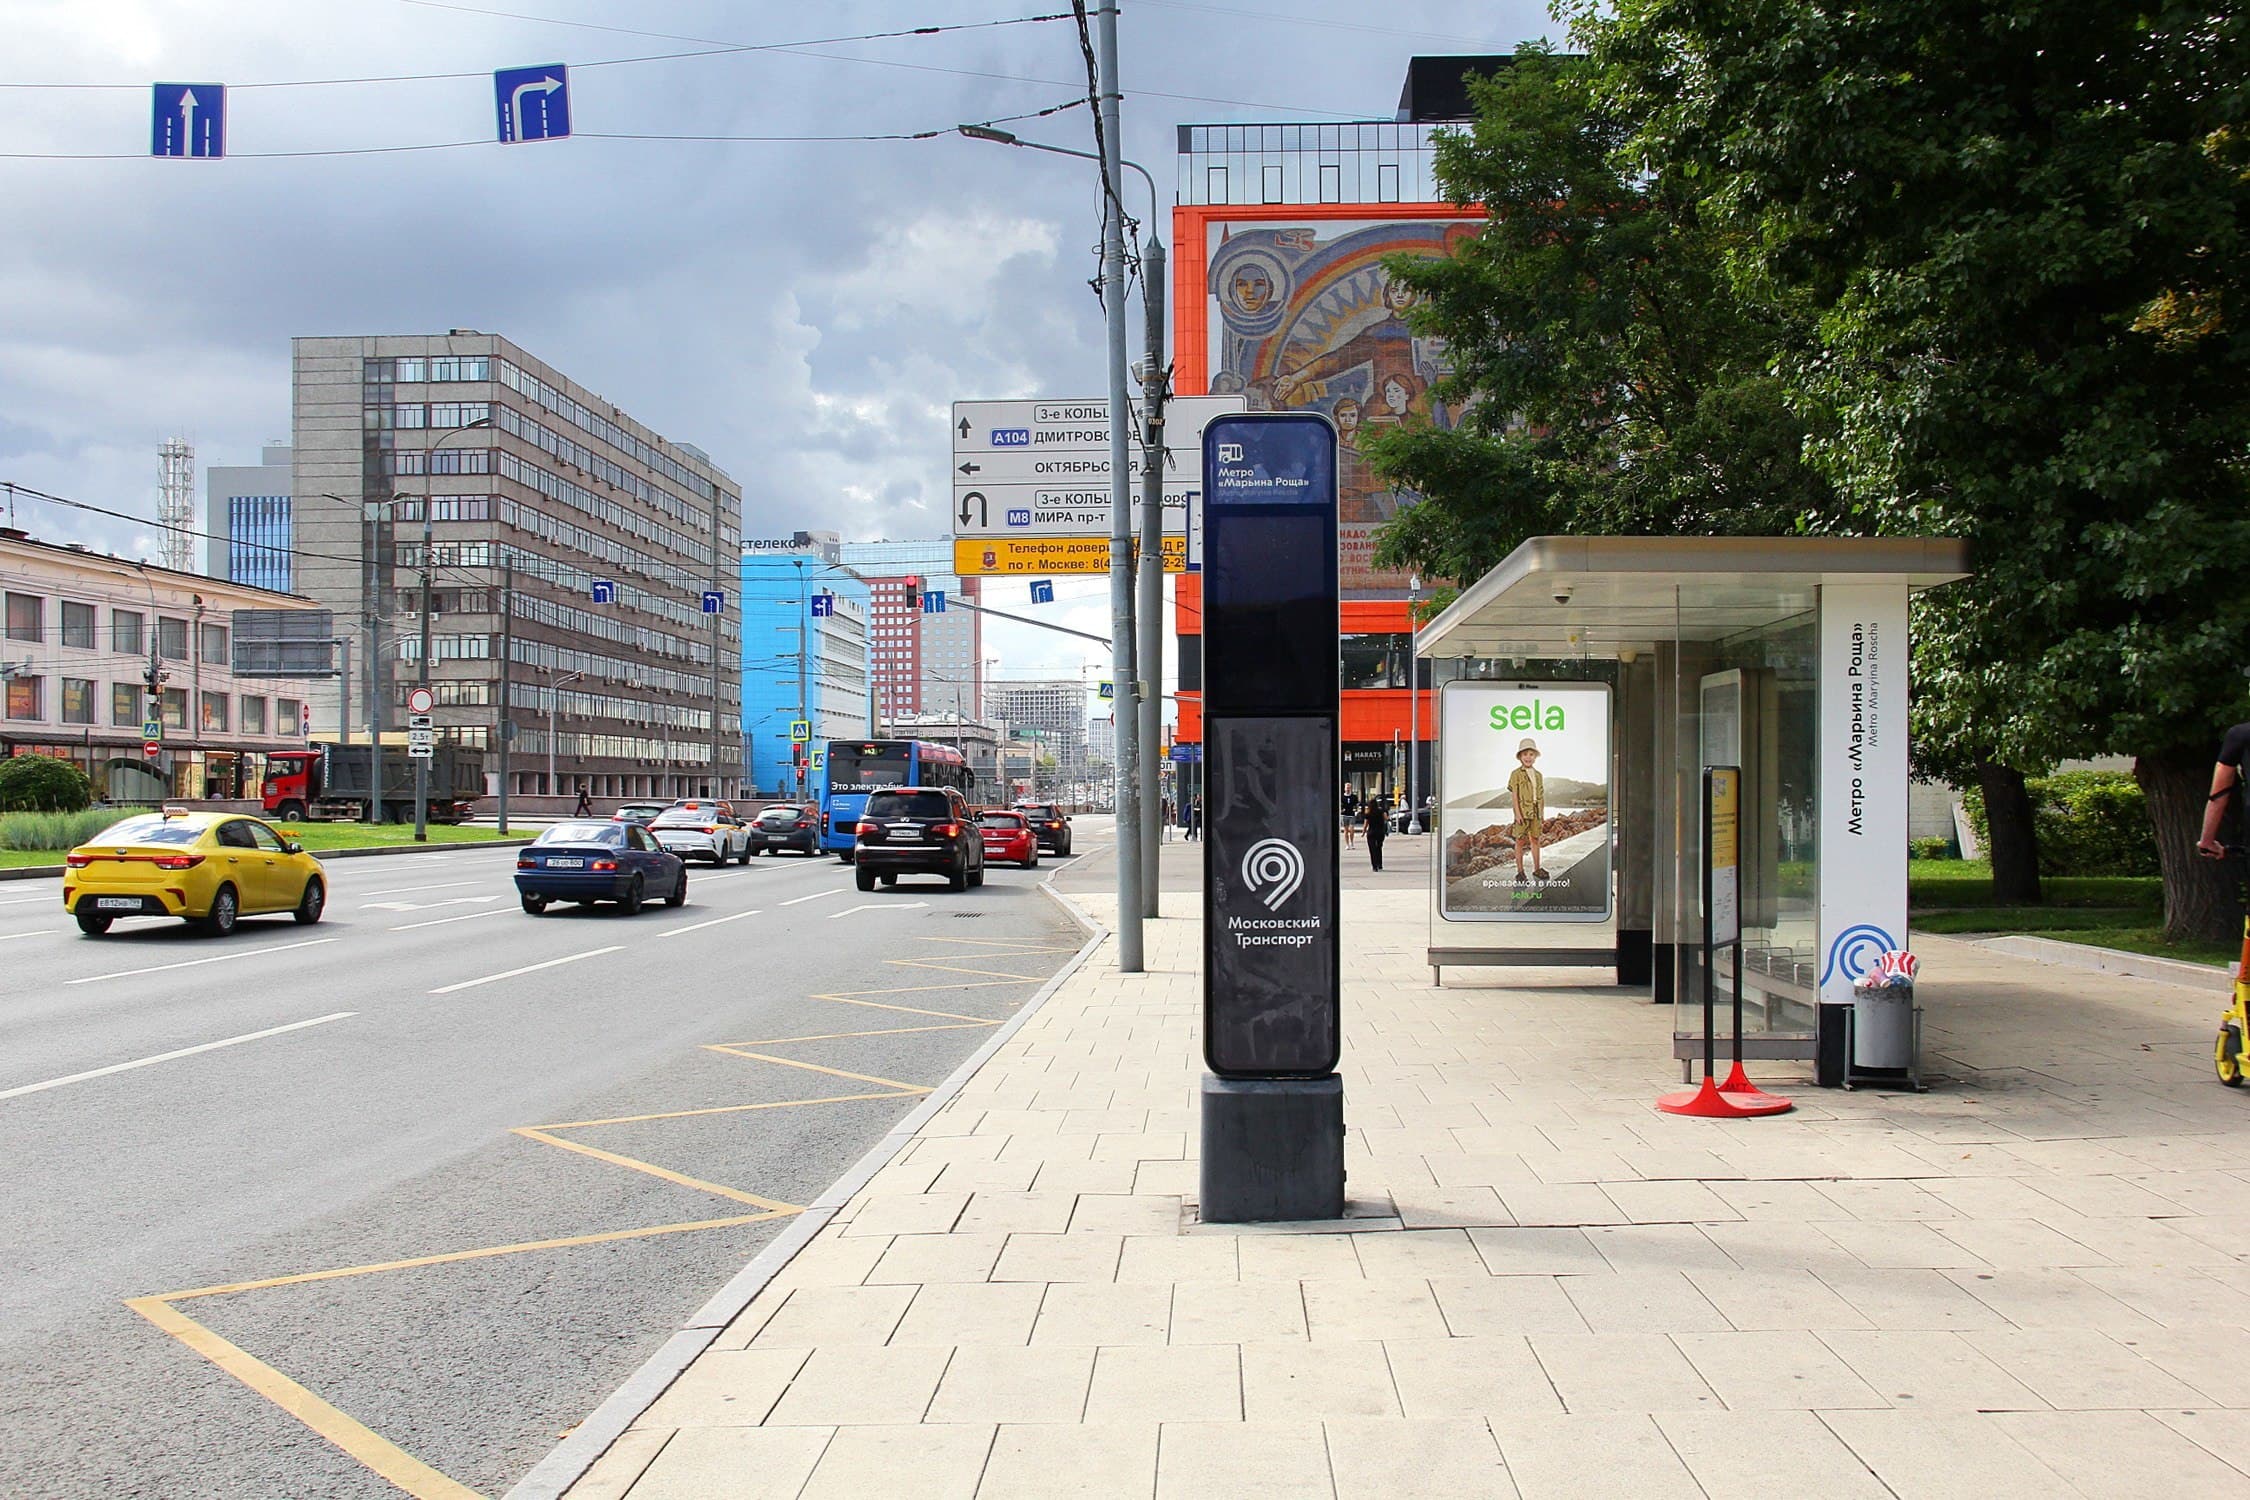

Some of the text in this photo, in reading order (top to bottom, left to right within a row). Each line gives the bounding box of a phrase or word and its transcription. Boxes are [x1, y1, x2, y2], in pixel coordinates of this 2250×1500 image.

[1041, 408, 1060, 420] 3-е
[994, 432, 1028, 444] А104
[1218, 468, 1254, 478] Метро
[1218, 477, 1309, 488] «Марьина Роща»
[1041, 494, 1060, 505] 3-е
[1010, 512, 1105, 524] М8 МИРА пр-т
[1008, 543, 1064, 555] Телефон
[1008, 561, 1023, 570] по
[1027, 561, 1034, 569] г.
[1038, 559, 1089, 570] Москве:
[1868, 622, 1880, 747] Metro Maryina Roscha
[1489, 699, 1565, 731] sela
[1848, 623, 1866, 835] Метро «Марьина Роща»
[831, 781, 849, 790] Это
[1511, 891, 1543, 899] sela.ru
[1228, 916, 1321, 929] Московский
[1235, 932, 1314, 949] Транспорт
